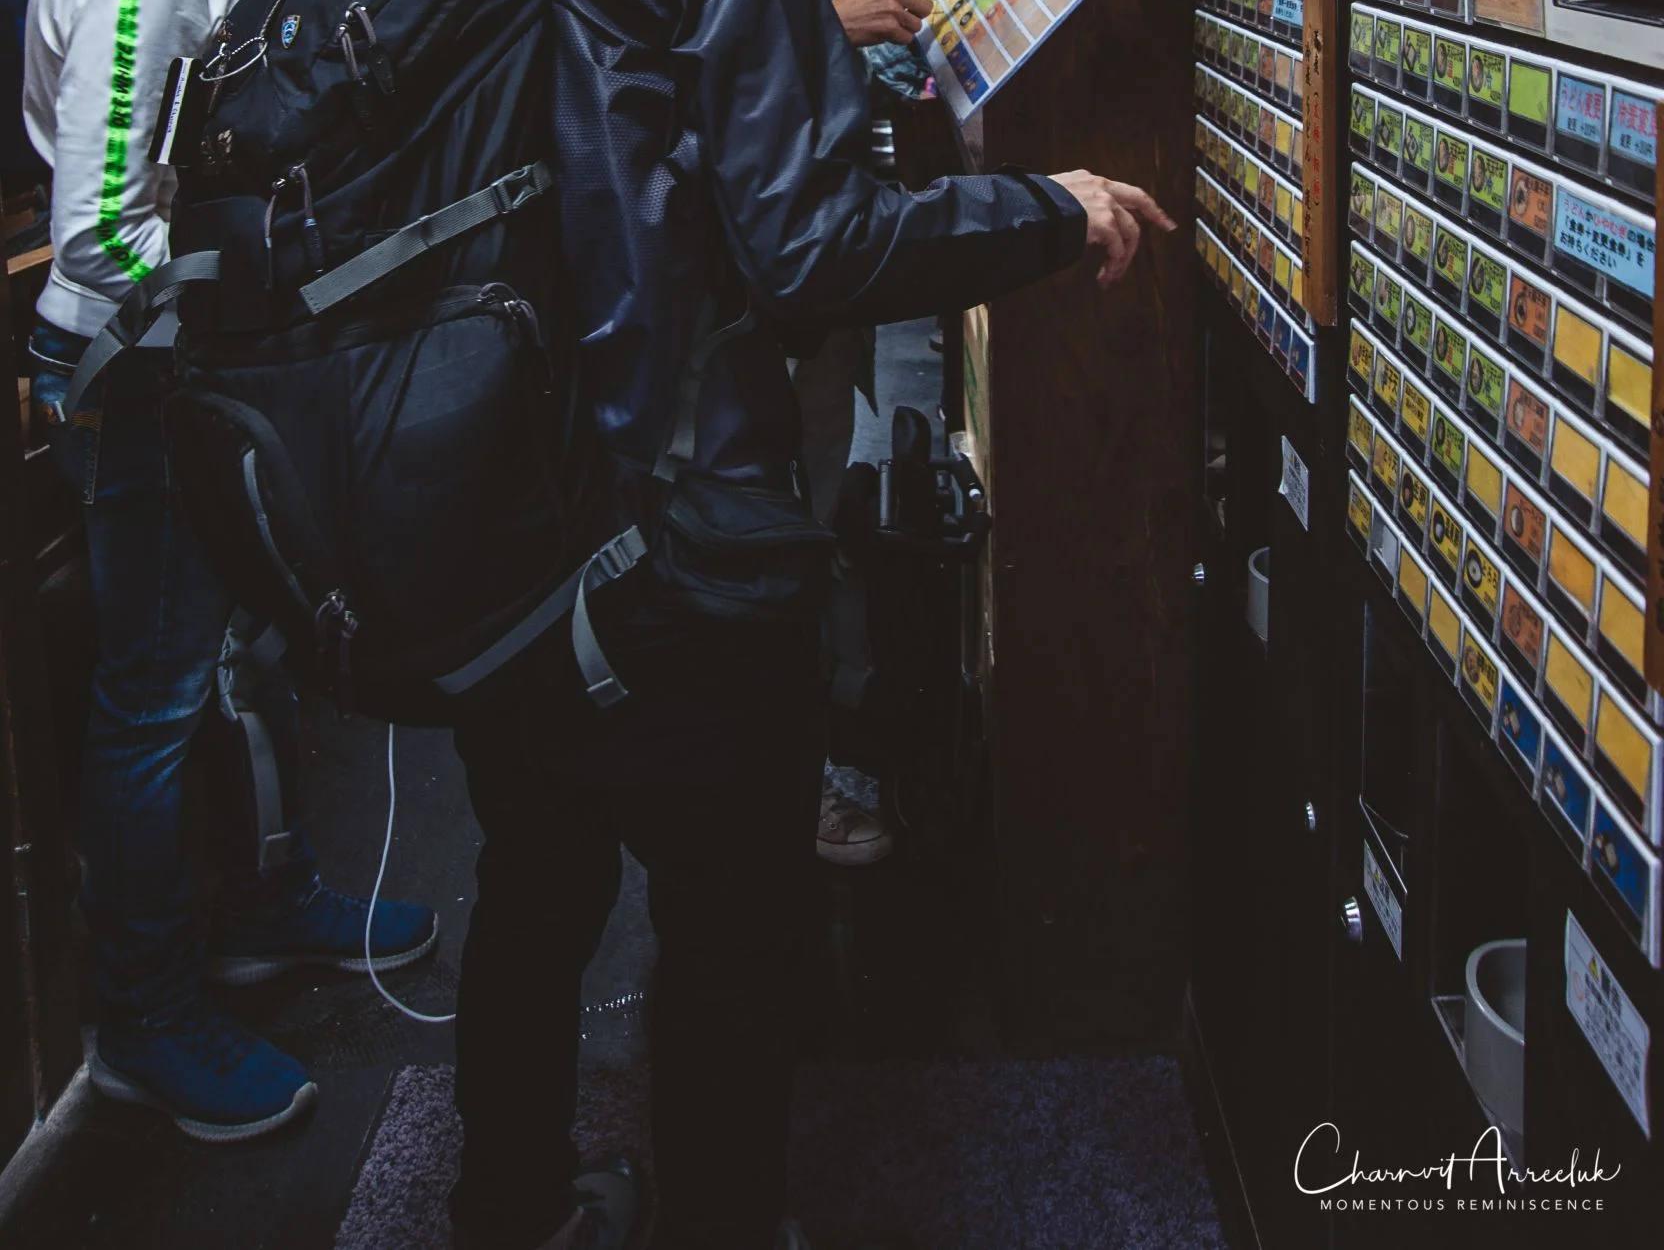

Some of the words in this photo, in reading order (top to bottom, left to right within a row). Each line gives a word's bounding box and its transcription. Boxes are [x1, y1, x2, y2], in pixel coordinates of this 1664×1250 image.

[1560, 231, 1618, 270] お持ちください
